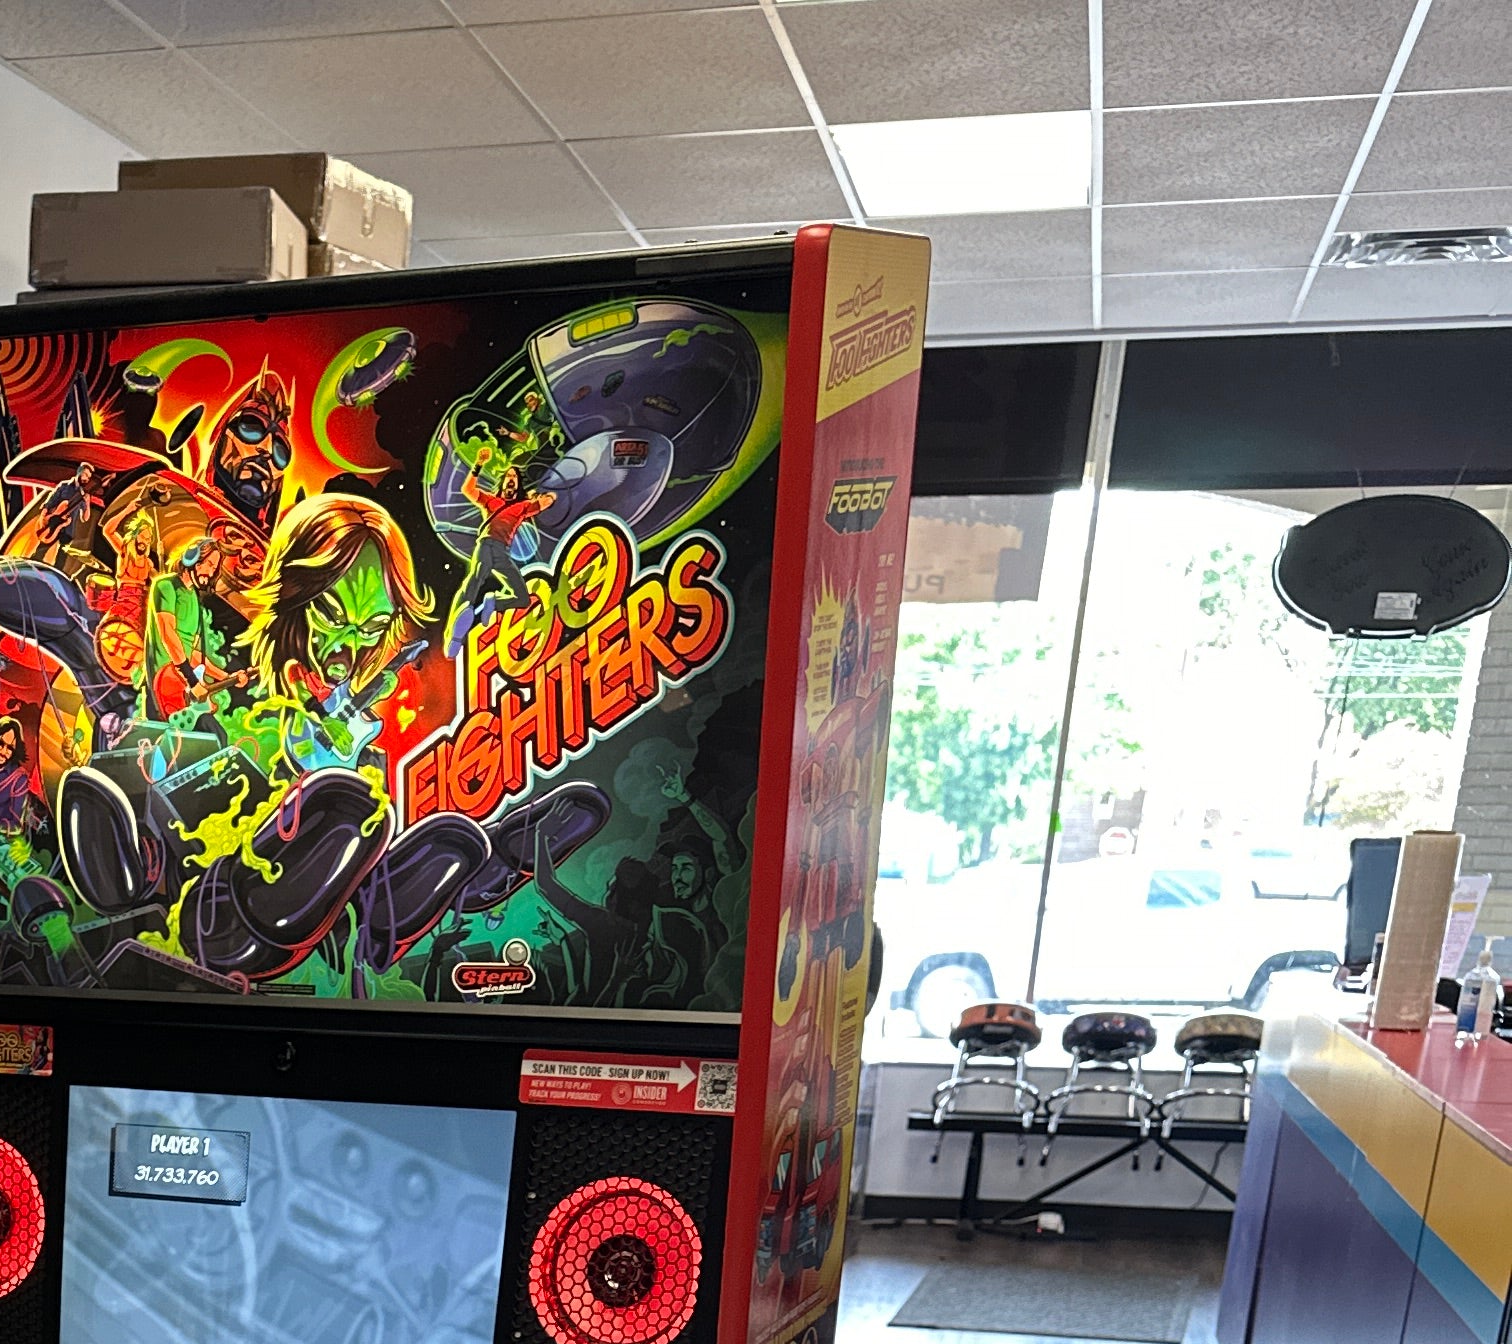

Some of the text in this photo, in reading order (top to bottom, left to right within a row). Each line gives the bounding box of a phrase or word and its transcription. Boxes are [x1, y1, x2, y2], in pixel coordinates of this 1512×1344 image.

[826, 306, 916, 391] FOO FIGHTERS
[828, 481, 894, 516] FOOBOT
[405, 527, 716, 828] FOO FIGHTERS
[462, 970, 525, 985] Stern
[479, 983, 522, 993] pinball
[531, 1062, 670, 1081] SCAN THIS CODE SIGN UP NOW!
[633, 1085, 667, 1101] INSIDER
[150, 1133, 211, 1156] PLAYER 1
